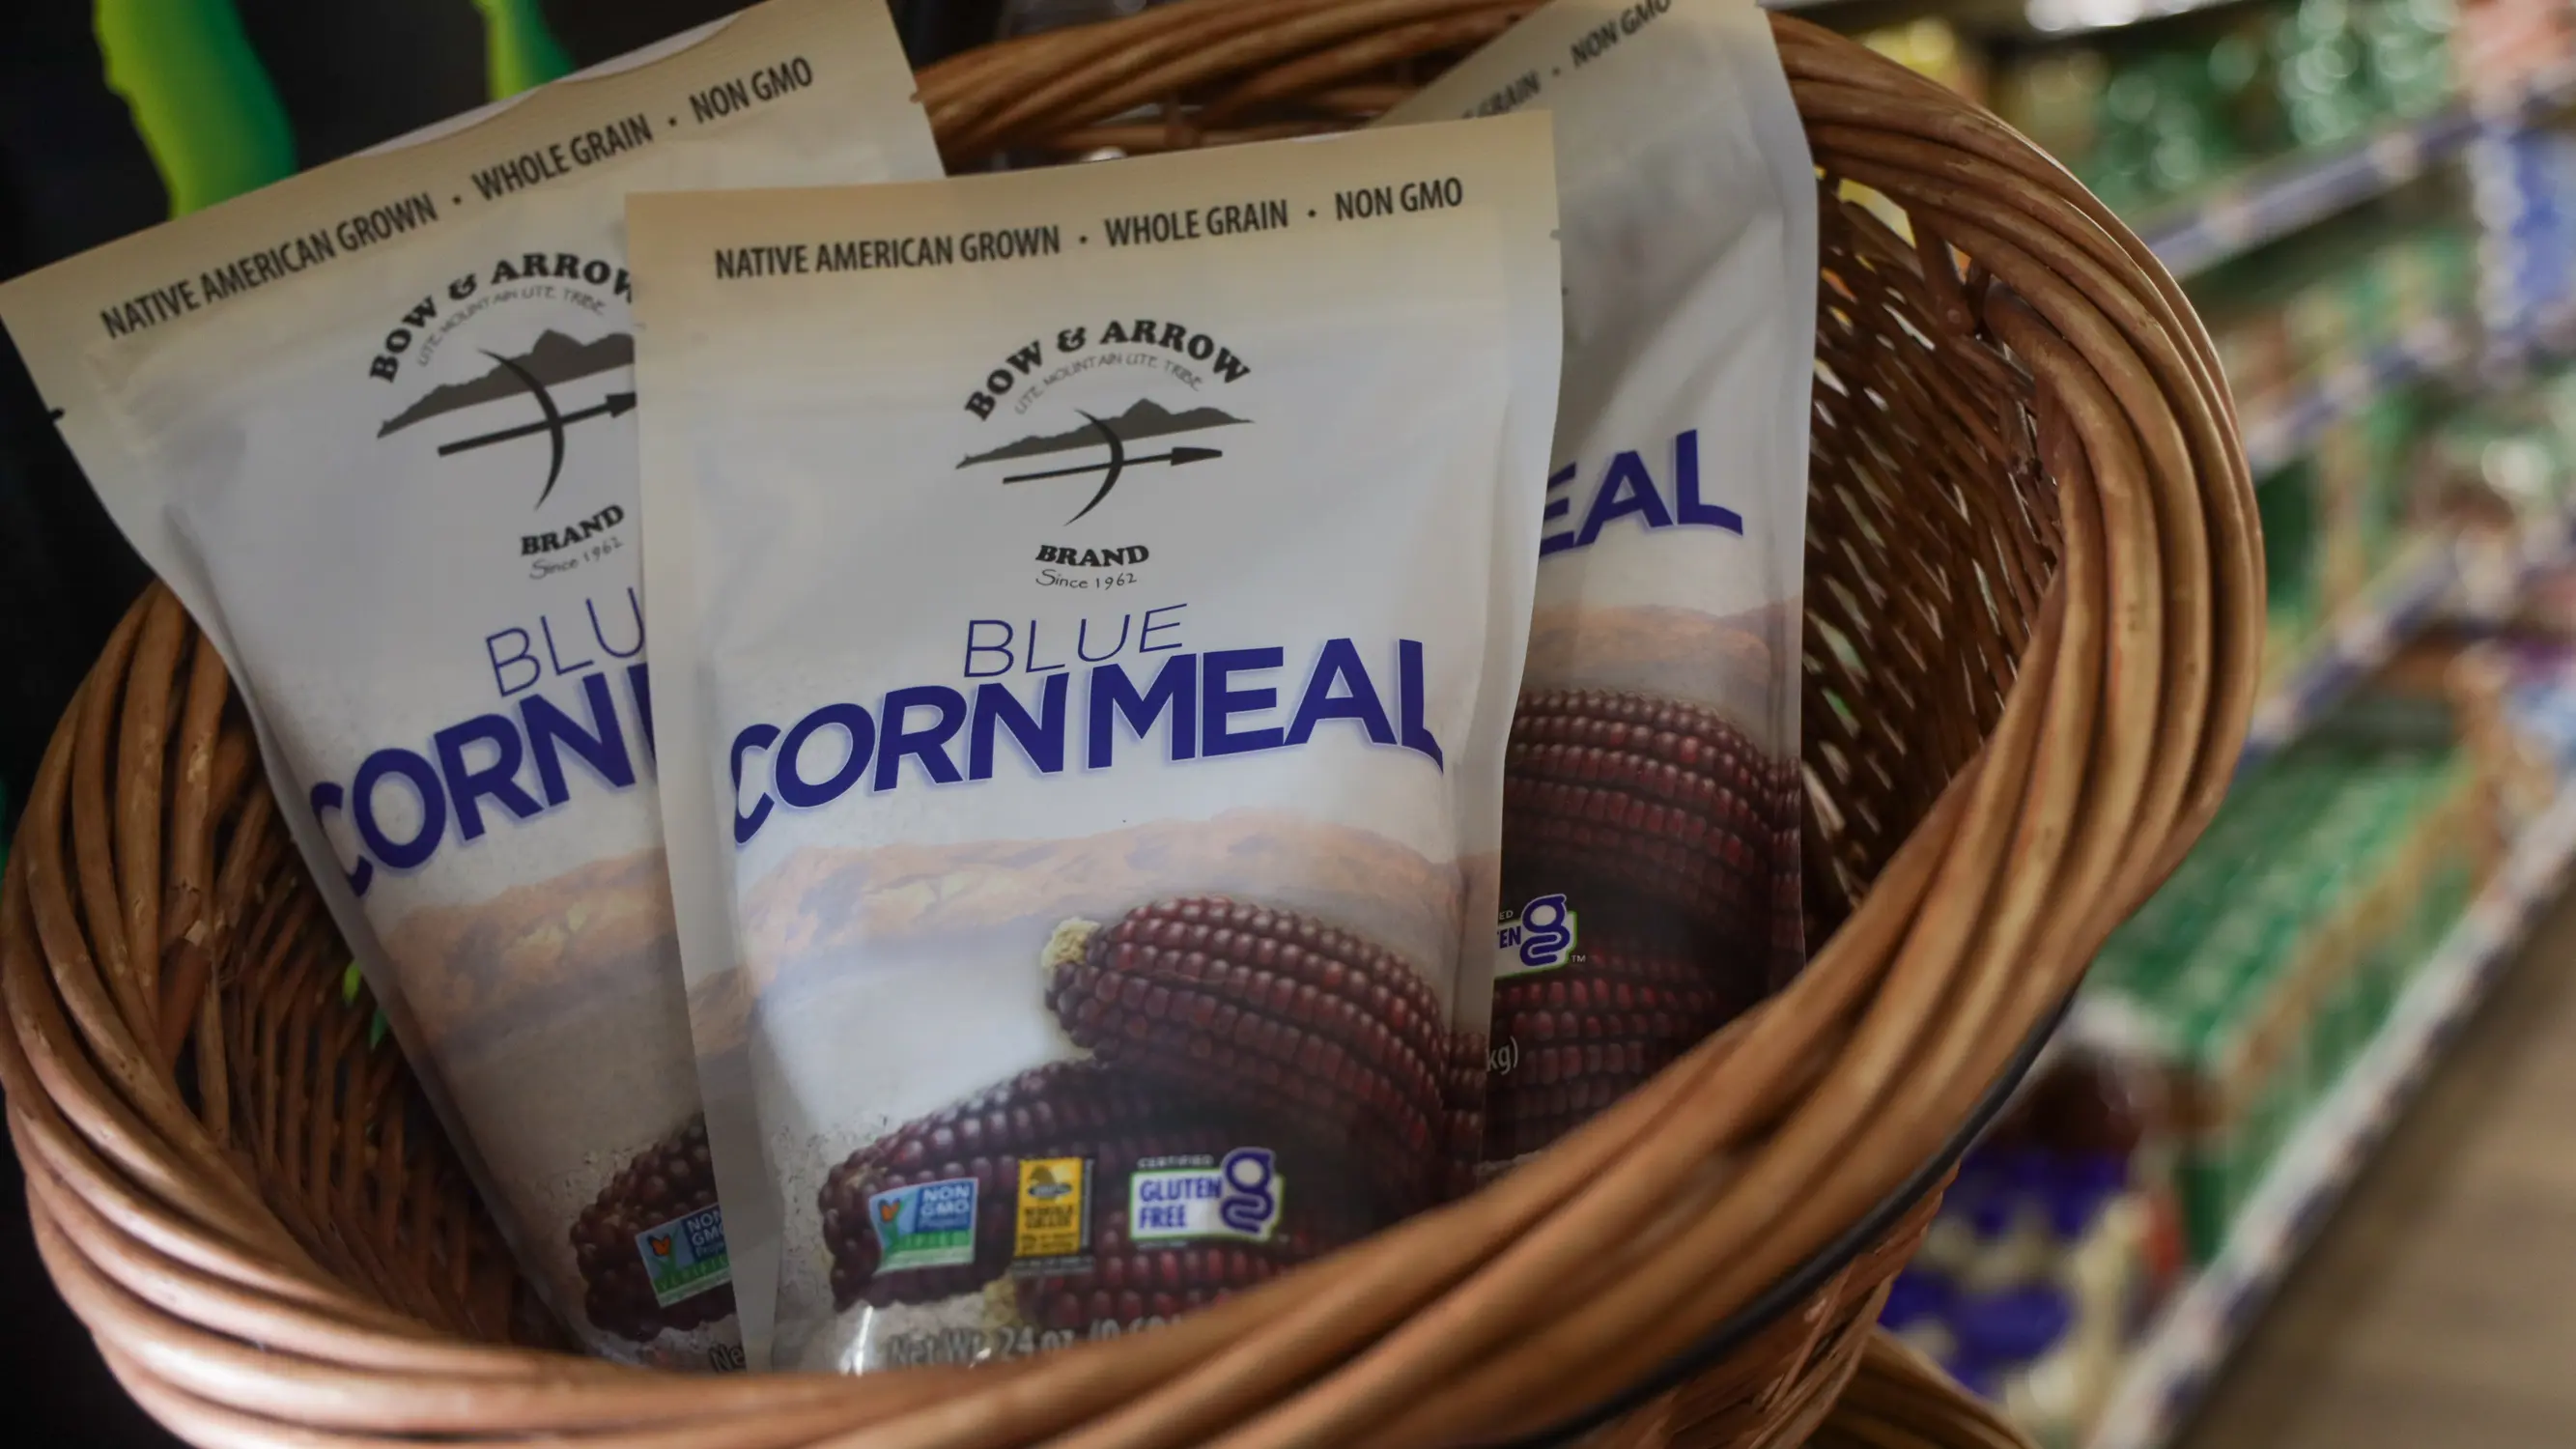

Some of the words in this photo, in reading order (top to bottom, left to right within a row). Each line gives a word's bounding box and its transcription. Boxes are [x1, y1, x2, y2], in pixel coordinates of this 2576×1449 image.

[1570, 19, 1619, 70] NON
[100, 279, 200, 338] NATIVE
[200, 230, 336, 302] AMERICAN
[337, 193, 439, 252] GROWN
[471, 143, 570, 202] WHOLE
[572, 114, 653, 168] GRAIN
[689, 78, 750, 124] NON
[751, 56, 813, 101] GMO
[715, 243, 809, 280] NATIVE
[815, 237, 954, 275] AMERICAN
[960, 225, 1062, 265] GROWN
[1105, 211, 1202, 248] WHOLE
[1205, 200, 1289, 239] GRAIN
[1335, 185, 1397, 223] NON
[1400, 177, 1463, 213] GMO
[369, 296, 438, 383] BOW
[448, 273, 477, 300] &
[416, 333, 444, 367] UTE
[440, 291, 517, 333] MOUNTAIN
[521, 285, 556, 299] UTE
[563, 287, 607, 317] TRIBE
[964, 339, 1043, 422] BOW
[1056, 327, 1087, 354] &
[1099, 319, 1252, 384] ARROW
[1014, 387, 1044, 415] UTE
[1043, 354, 1123, 387] MOUNTAIN
[1126, 354, 1159, 369] UTE
[1165, 359, 1203, 391] TRIBE
[1540, 429, 1743, 558] EAL
[521, 504, 625, 556] BRAND
[1034, 544, 1149, 568] BRAND
[529, 557, 580, 580] Since
[583, 537, 625, 563] 1962
[1035, 568, 1089, 589] Since
[1094, 571, 1138, 590] 1962
[486, 587, 644, 697] BLU
[964, 603, 1188, 679] BLUE
[920, 1199, 970, 1217] GMO
[923, 1185, 971, 1202] NON
[1140, 1177, 1221, 1202] GLUTEN
[1139, 1205, 1186, 1229] FREE
[708, 1343, 745, 1373] Ne
